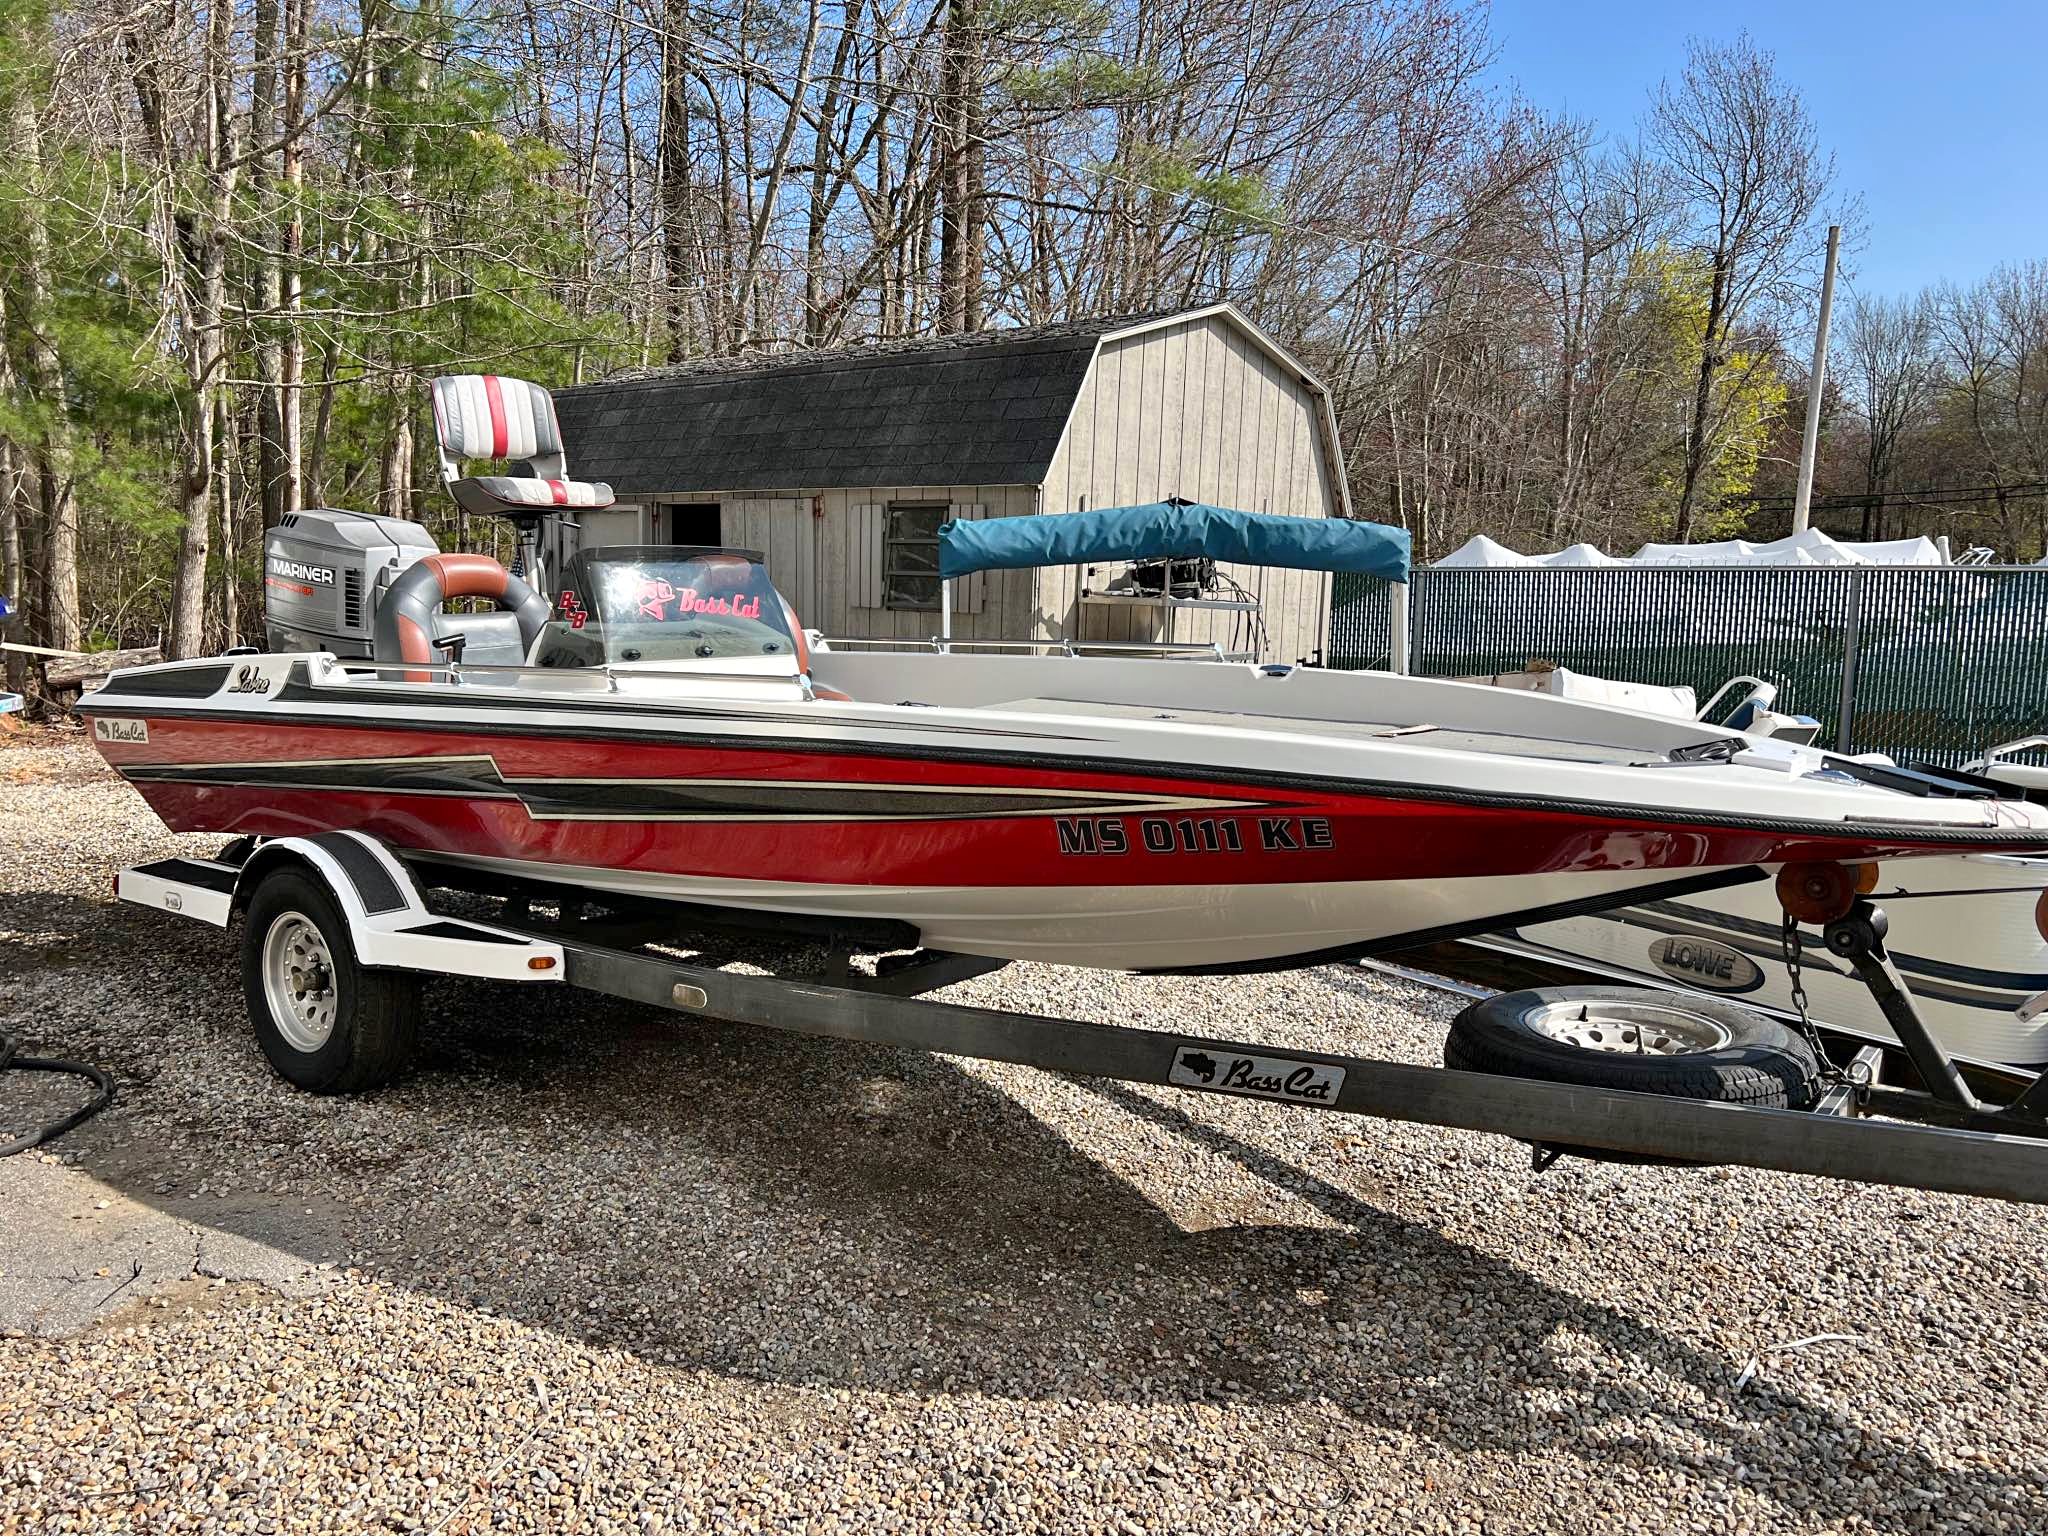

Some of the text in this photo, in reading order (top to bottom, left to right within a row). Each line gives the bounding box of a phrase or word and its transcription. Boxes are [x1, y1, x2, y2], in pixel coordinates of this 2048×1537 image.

[273, 559, 333, 584] MARINER
[676, 587, 761, 618] Bass Cat
[227, 664, 271, 694] Sabre
[1055, 817, 1128, 853] MS
[1140, 817, 1243, 852] 0111
[1663, 939, 1736, 980] LOWE
